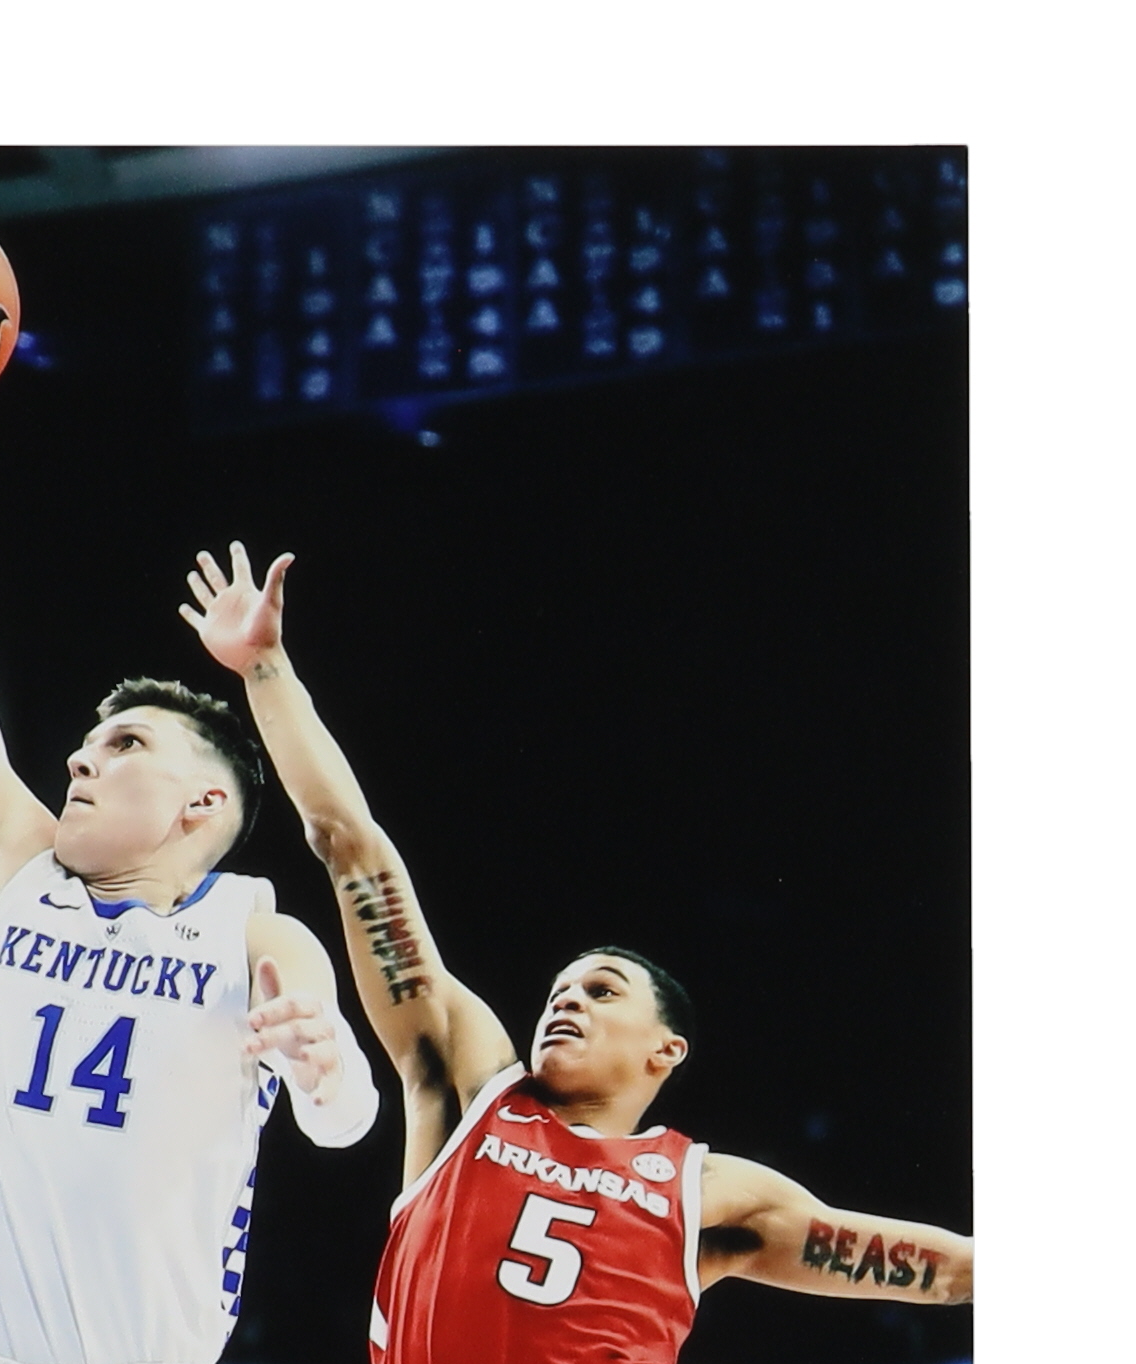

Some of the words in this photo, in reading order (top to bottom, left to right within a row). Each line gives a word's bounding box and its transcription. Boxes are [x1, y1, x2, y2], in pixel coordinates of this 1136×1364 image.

[12, 1002, 138, 1131] 14
[475, 1134, 670, 1218] ARKANSAS
[496, 1192, 597, 1307] 5
[802, 1217, 948, 1293] BEAST
